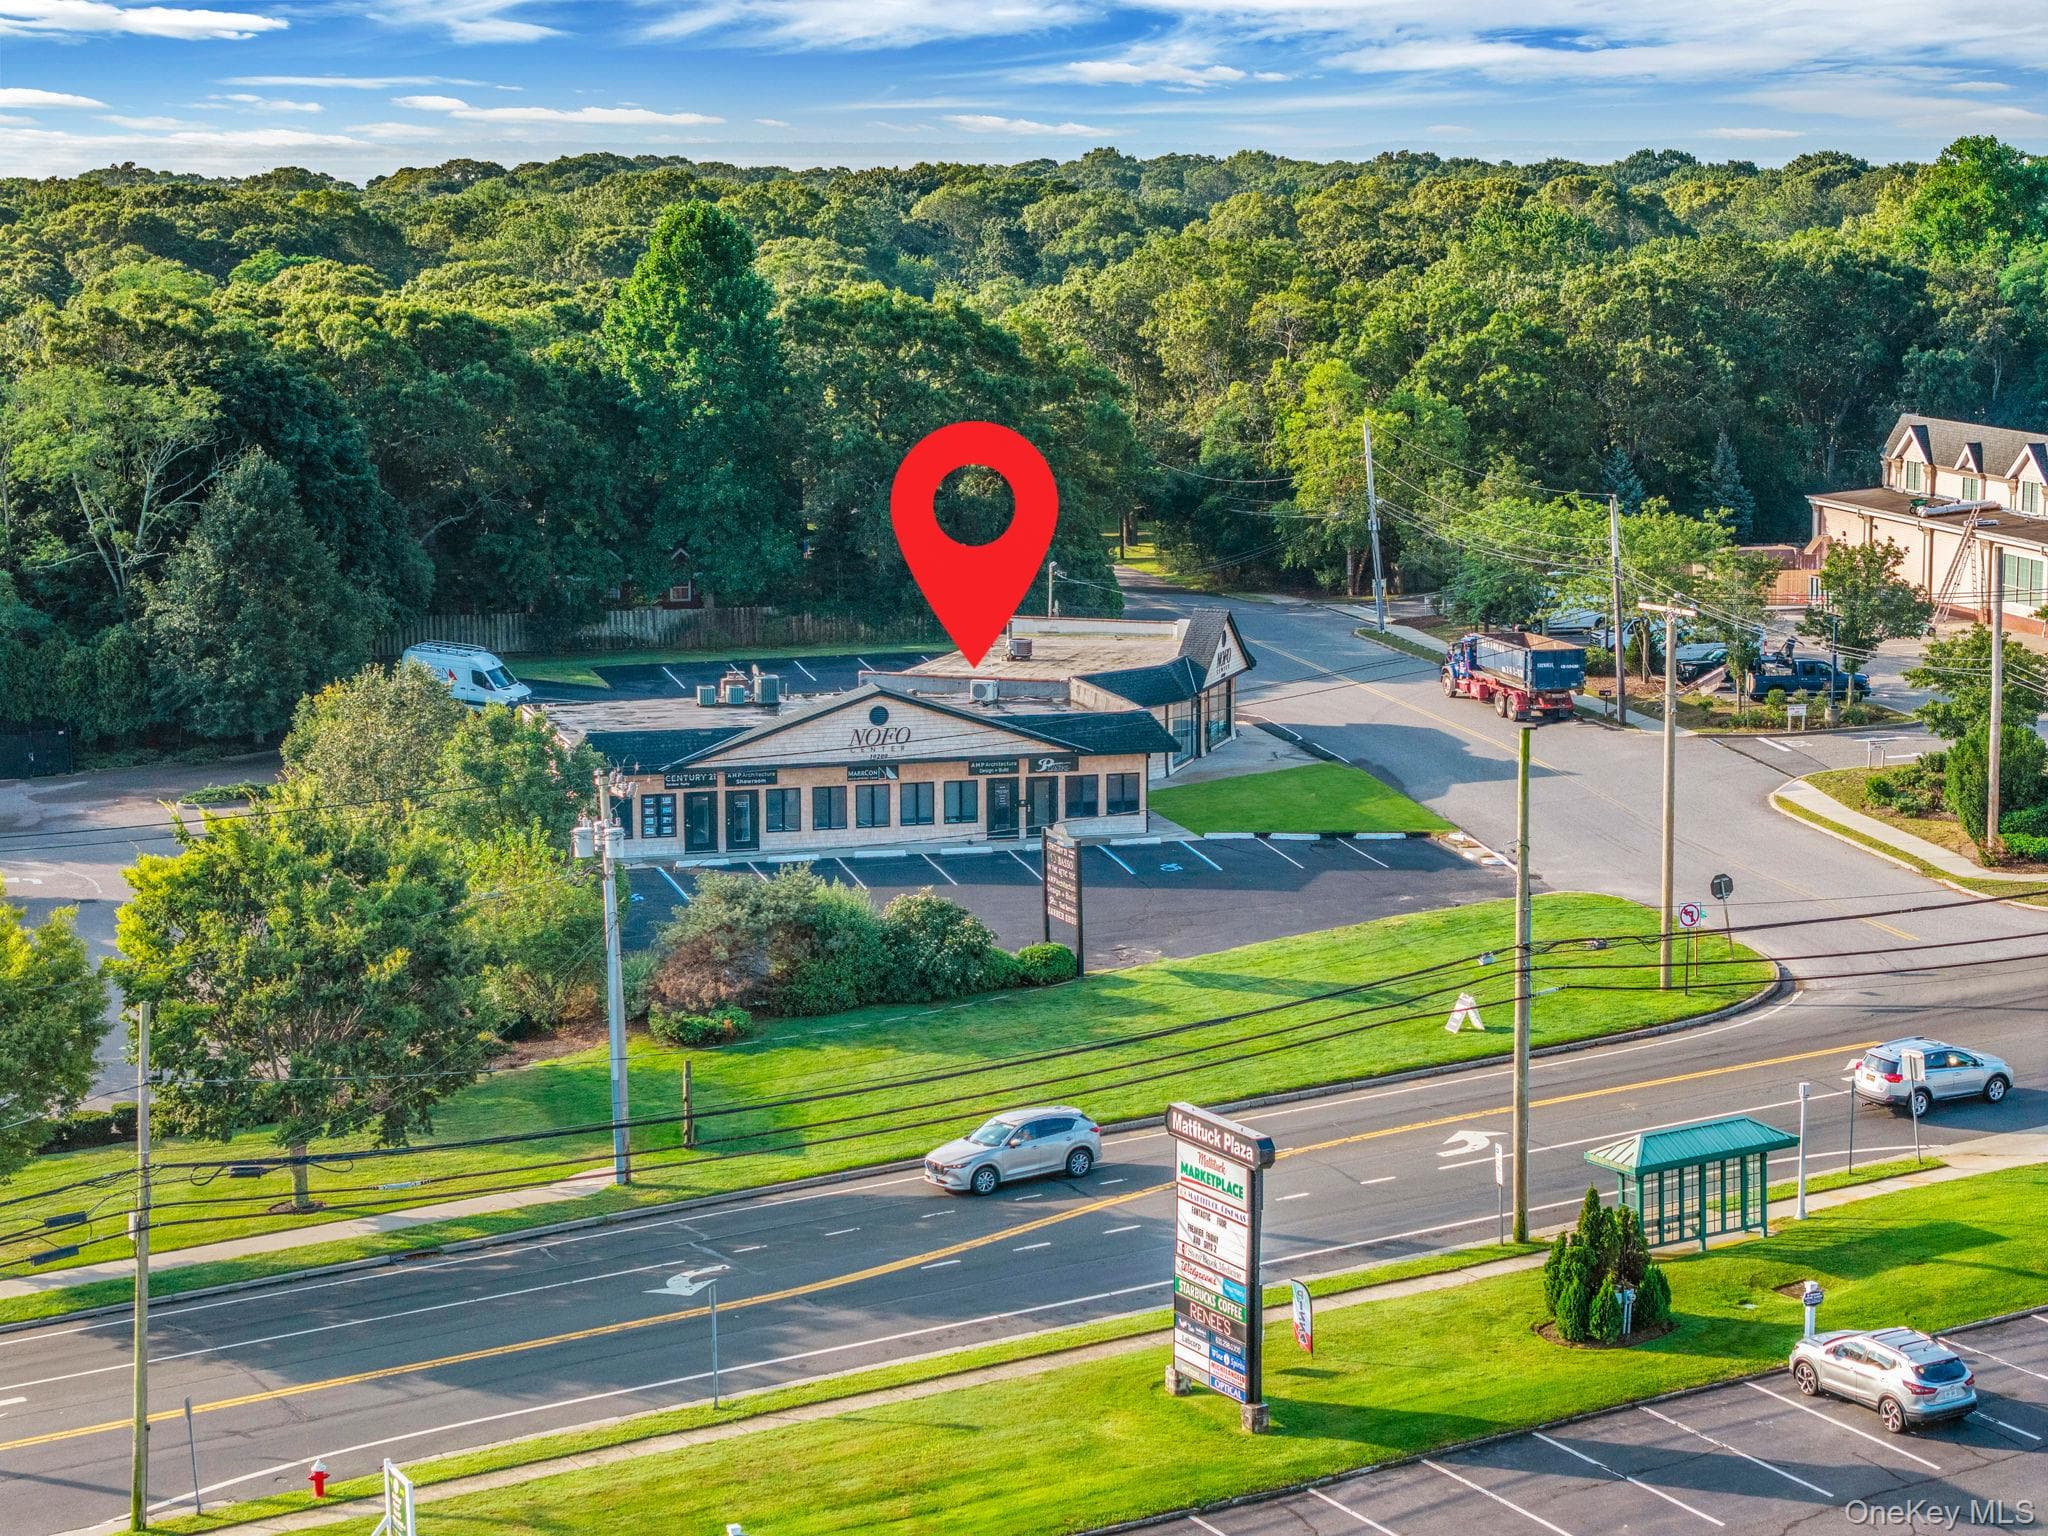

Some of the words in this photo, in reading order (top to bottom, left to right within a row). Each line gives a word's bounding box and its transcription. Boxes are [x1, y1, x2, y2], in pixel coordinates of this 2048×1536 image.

[848, 727, 911, 746] NOFO
[665, 774, 706, 782] CENTURY
[709, 773, 717, 781] 21
[1172, 1111, 1221, 1148] Mattituck
[1224, 1132, 1253, 1161] Plaza
[1181, 1161, 1243, 1199] MARKETPLACE
[1192, 1206, 1211, 1221] FANTASTIC
[1217, 1217, 1227, 1229] FOUR
[1221, 1205, 1246, 1223] CINEMAS
[1206, 1231, 1219, 1243] FRIDAY
[1213, 1245, 1218, 1254] 2
[1180, 1260, 1217, 1285] Walgreens
[1179, 1279, 1216, 1307] STARBUCKS
[1218, 1297, 1242, 1319] COFFEE
[1190, 1302, 1231, 1336] RENEE'S
[1181, 1335, 1202, 1351] Labcorp
[1211, 1348, 1224, 1360] Wine
[1230, 1356, 1246, 1371] Spirits
[1215, 1380, 1241, 1400] OPTICAL
